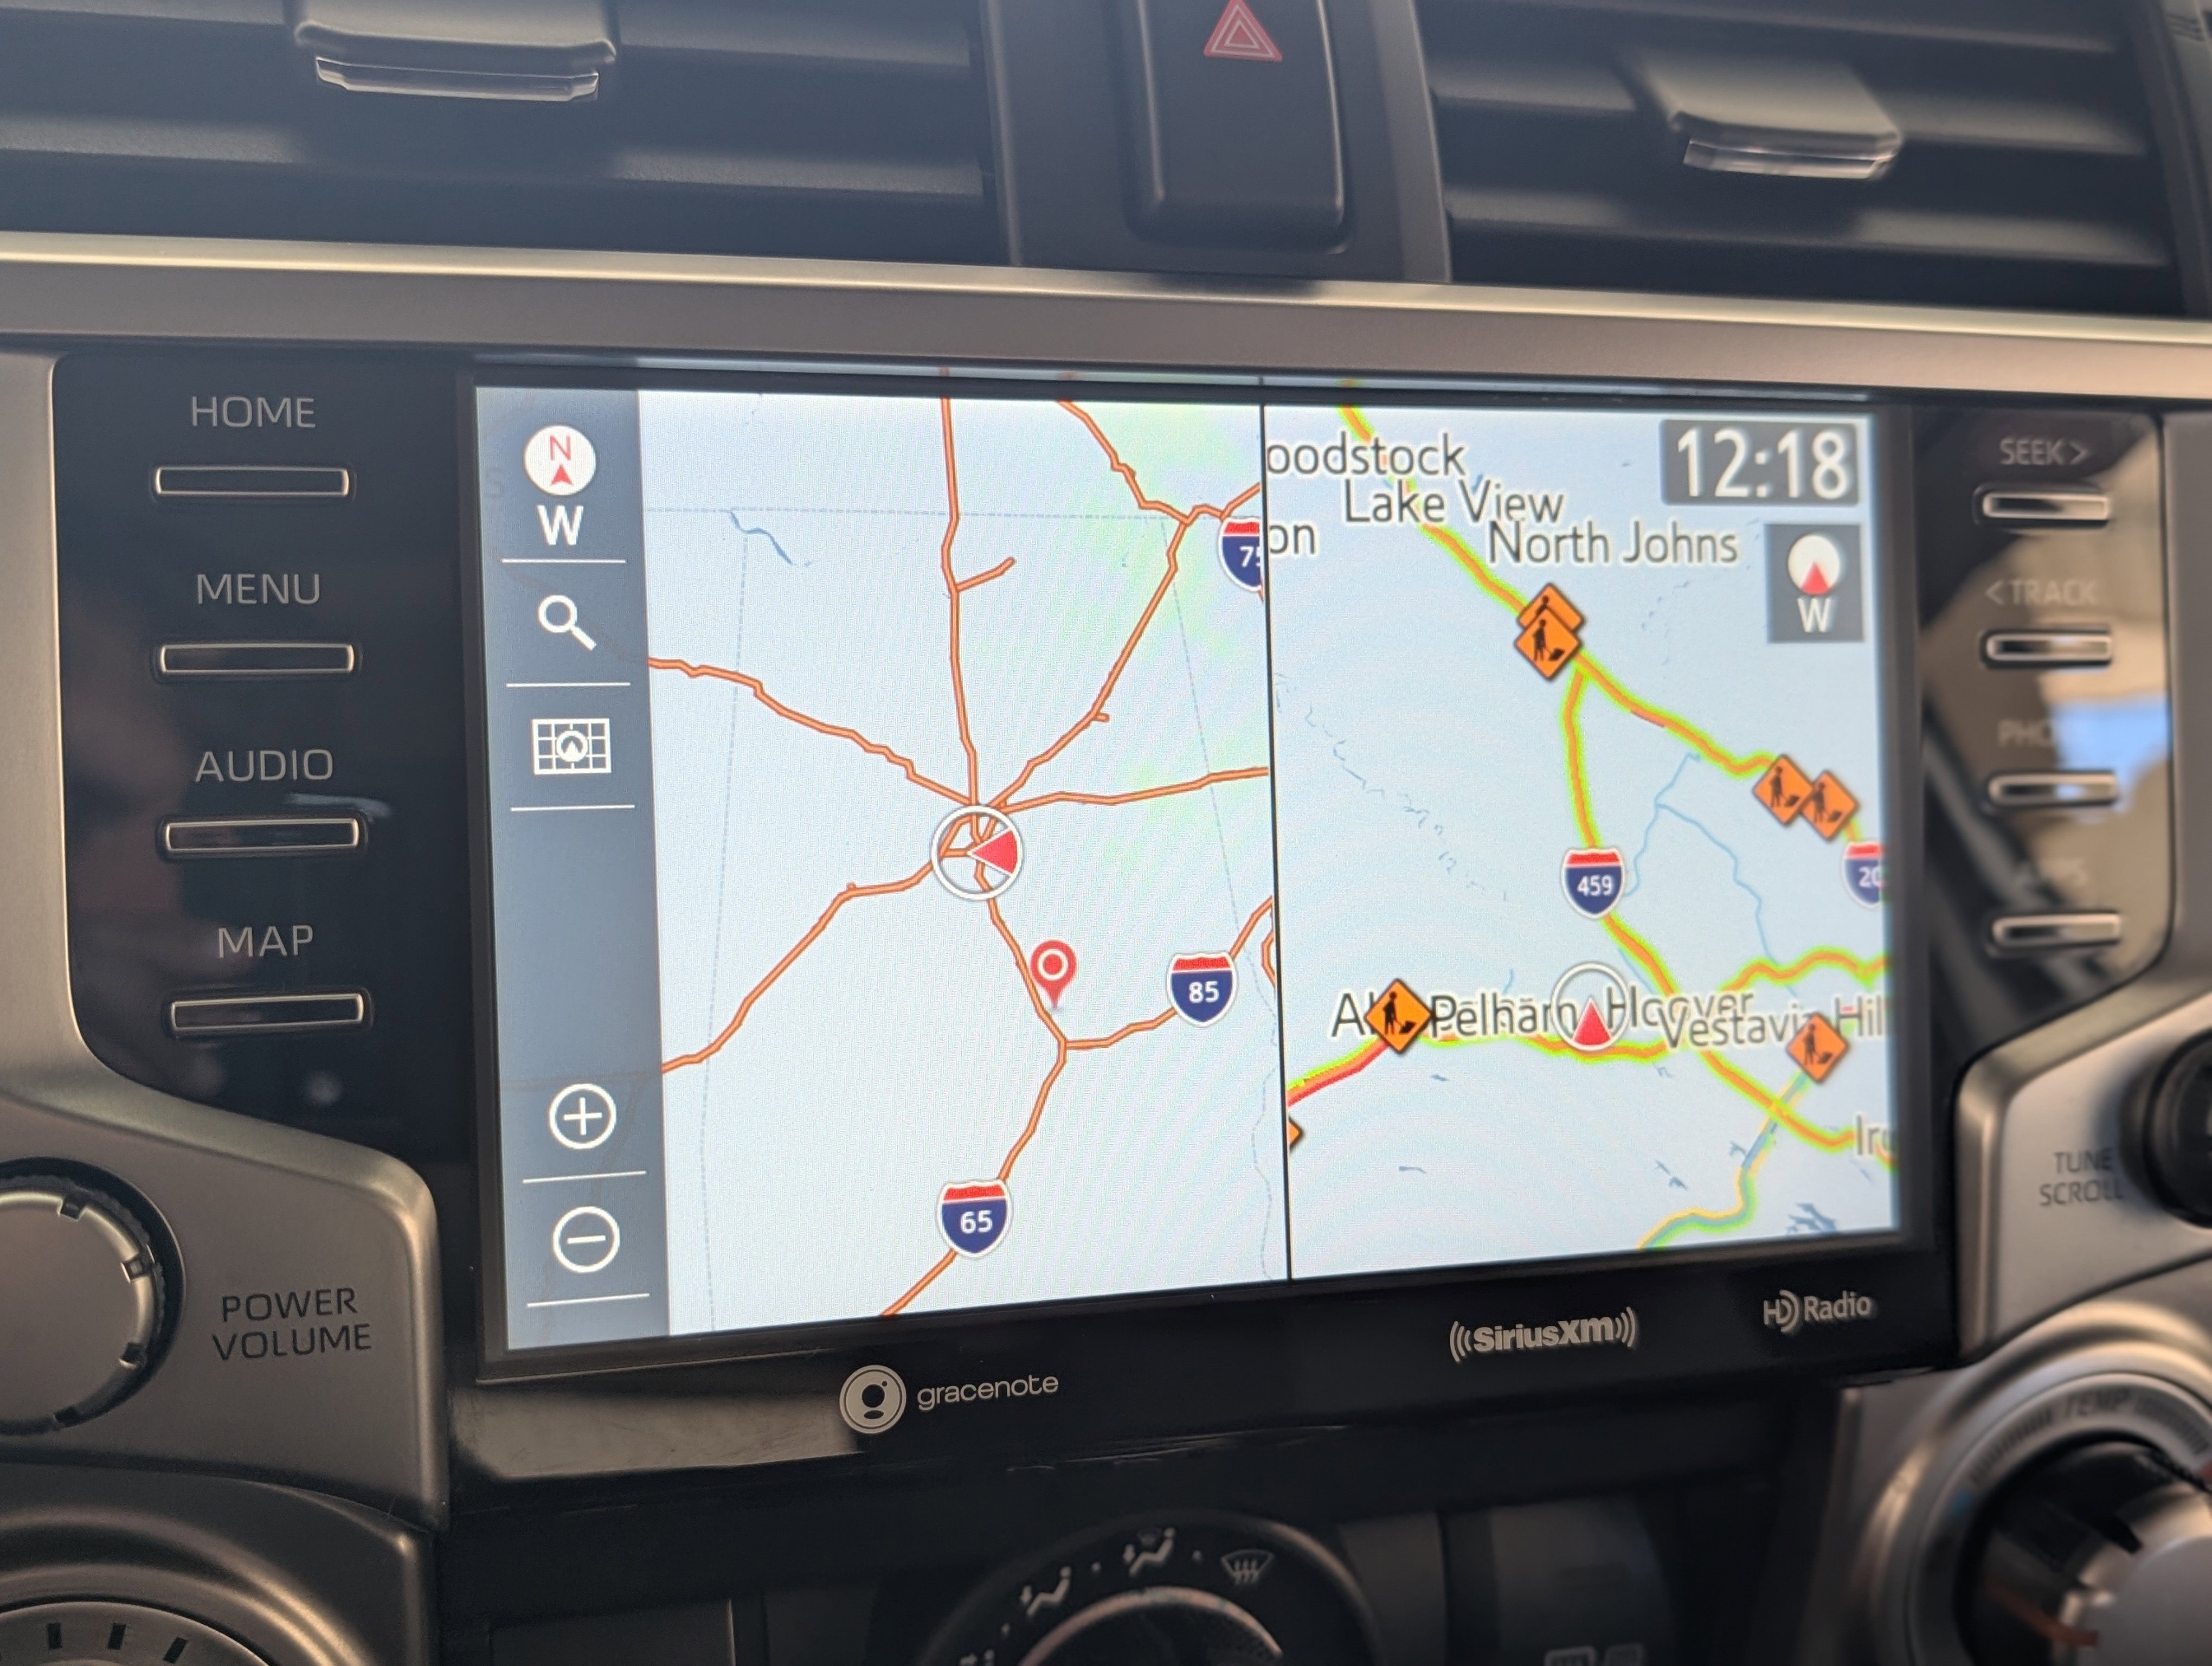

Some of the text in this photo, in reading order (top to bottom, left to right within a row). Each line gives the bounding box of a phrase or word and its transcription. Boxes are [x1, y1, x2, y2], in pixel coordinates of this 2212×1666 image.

[191, 396, 316, 428] HOME
[549, 435, 571, 461] N
[1266, 431, 1465, 476] oodstock
[1677, 428, 1848, 499] 12:18
[1344, 479, 1564, 523] Lake View
[536, 505, 584, 546] W
[1269, 524, 1316, 554] on
[1489, 520, 1738, 565] North Johns
[197, 573, 320, 605] MENU
[2008, 579, 2099, 606] TRACK
[1798, 598, 1832, 633] W
[195, 748, 334, 783] AUDIO
[1577, 874, 1613, 896] 459
[218, 924, 314, 958] MAP
[1189, 981, 1219, 1003] 85
[1606, 985, 1755, 1028] Hoover
[1431, 991, 1577, 1038] Pelham
[1657, 1002, 1814, 1048] Vestavi
[2054, 1148, 2113, 1174] TUNE
[2039, 1180, 2124, 1207] SCROLL
[960, 1209, 993, 1234] 65
[222, 1287, 358, 1322] POWER
[1763, 1289, 1872, 1332] HD Radio
[212, 1323, 372, 1361] VOLUME
[917, 1374, 1059, 1411] gracenote
